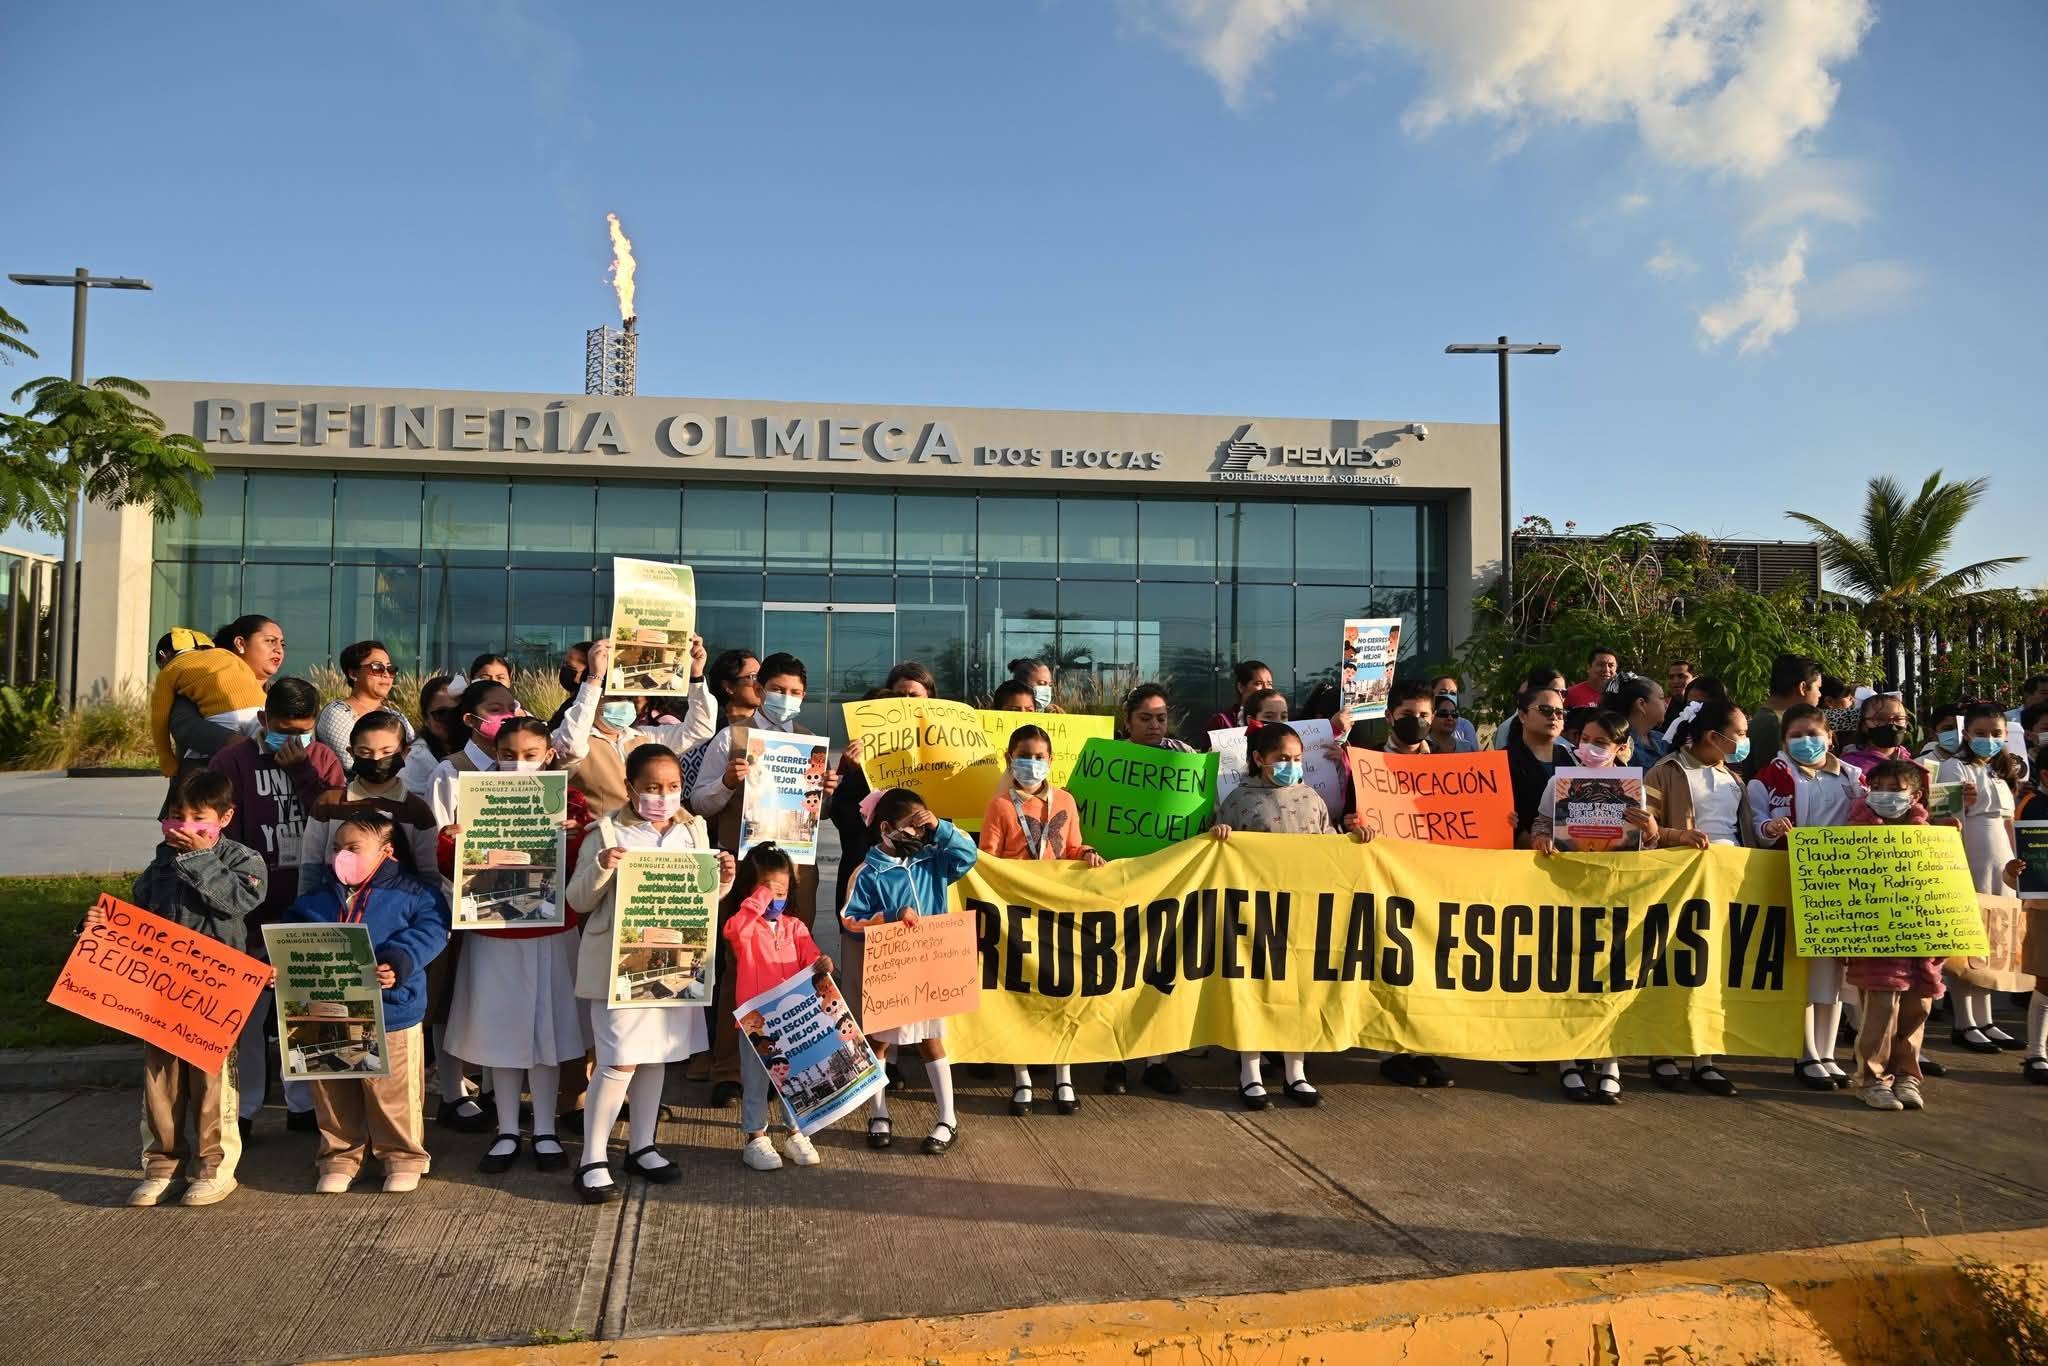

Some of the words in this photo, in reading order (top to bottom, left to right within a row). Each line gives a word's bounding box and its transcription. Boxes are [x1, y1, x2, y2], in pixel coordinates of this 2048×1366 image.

[205, 399, 628, 453] REFINERÍA
[668, 413, 961, 464] OLMECA
[984, 447, 1042, 467] DOS
[1060, 449, 1164, 471] BOCAS
[1282, 446, 1386, 467] PEMEX
[1220, 472, 1244, 481] POR
[1244, 473, 1259, 481] EL
[1259, 473, 1307, 482] RESCATE
[1308, 475, 1322, 483] DE
[1322, 475, 1338, 484] LA
[855, 699, 976, 727] Solicitamos
[776, 756, 807, 765] CIERRES
[1075, 750, 1104, 778] NO
[1108, 758, 1208, 793] CIERREN
[1358, 758, 1497, 796] REUBICACIÓN
[473, 817, 511, 827] nuestras
[540, 816, 551, 825] de
[1107, 805, 1209, 841] ESCUELA
[1394, 811, 1479, 841] CIERRE
[464, 840, 475, 849] de
[477, 840, 515, 849] nuestras
[1795, 832, 1819, 845] Sra
[1884, 830, 1896, 844] de
[1902, 832, 1912, 844] la
[1796, 847, 1850, 862] Claudia
[1857, 846, 1923, 860] Sheinbaum
[1817, 862, 1888, 878] Gobernador
[1895, 861, 1912, 872] del
[1917, 861, 1944, 871] Estado
[1798, 878, 1841, 891] Javier
[1849, 878, 1876, 893] May
[631, 894, 666, 904] nuestras
[693, 894, 704, 904] de
[1800, 895, 1842, 908] Padres
[1848, 894, 1862, 906] de
[1890, 907, 1902, 918] la
[622, 917, 632, 927] de
[634, 917, 668, 927] nuestras
[929, 918, 964, 930] nuestro
[1805, 922, 1819, 934] de
[1826, 921, 1879, 934] nuestras
[101, 899, 131, 927] No
[138, 922, 168, 943] me
[242, 972, 263, 987] mi
[913, 936, 944, 949] mejor
[966, 888, 1291, 997] REUBIQUEN
[1313, 892, 1415, 986] LAS
[1435, 899, 1711, 994] ESCUELAS
[1728, 902, 1787, 991] YA
[1804, 935, 1816, 944] ar
[1822, 935, 1839, 943] con
[1843, 932, 1890, 945] nuestras
[1896, 930, 1931, 940] clases
[1937, 929, 1949, 938] de
[1872, 943, 1917, 954] nuestros
[1924, 940, 1970, 952] Derechos
[290, 951, 304, 962] No
[306, 952, 333, 962] somos
[336, 952, 354, 961] una
[867, 956, 917, 974] reubiquen
[920, 953, 929, 962] el
[176, 962, 227, 990] mejor
[288, 964, 322, 975] escuela
[77, 939, 243, 1034] REUBIQUENLA
[289, 978, 316, 987] somos
[318, 979, 336, 987] una
[338, 977, 362, 991] gran
[310, 989, 344, 1000] escuela
[766, 1017, 781, 1030] NO
[782, 995, 818, 1021] CIERRES
[787, 1021, 820, 1045] MEJOR
[784, 1025, 835, 1060] REUBICALA
